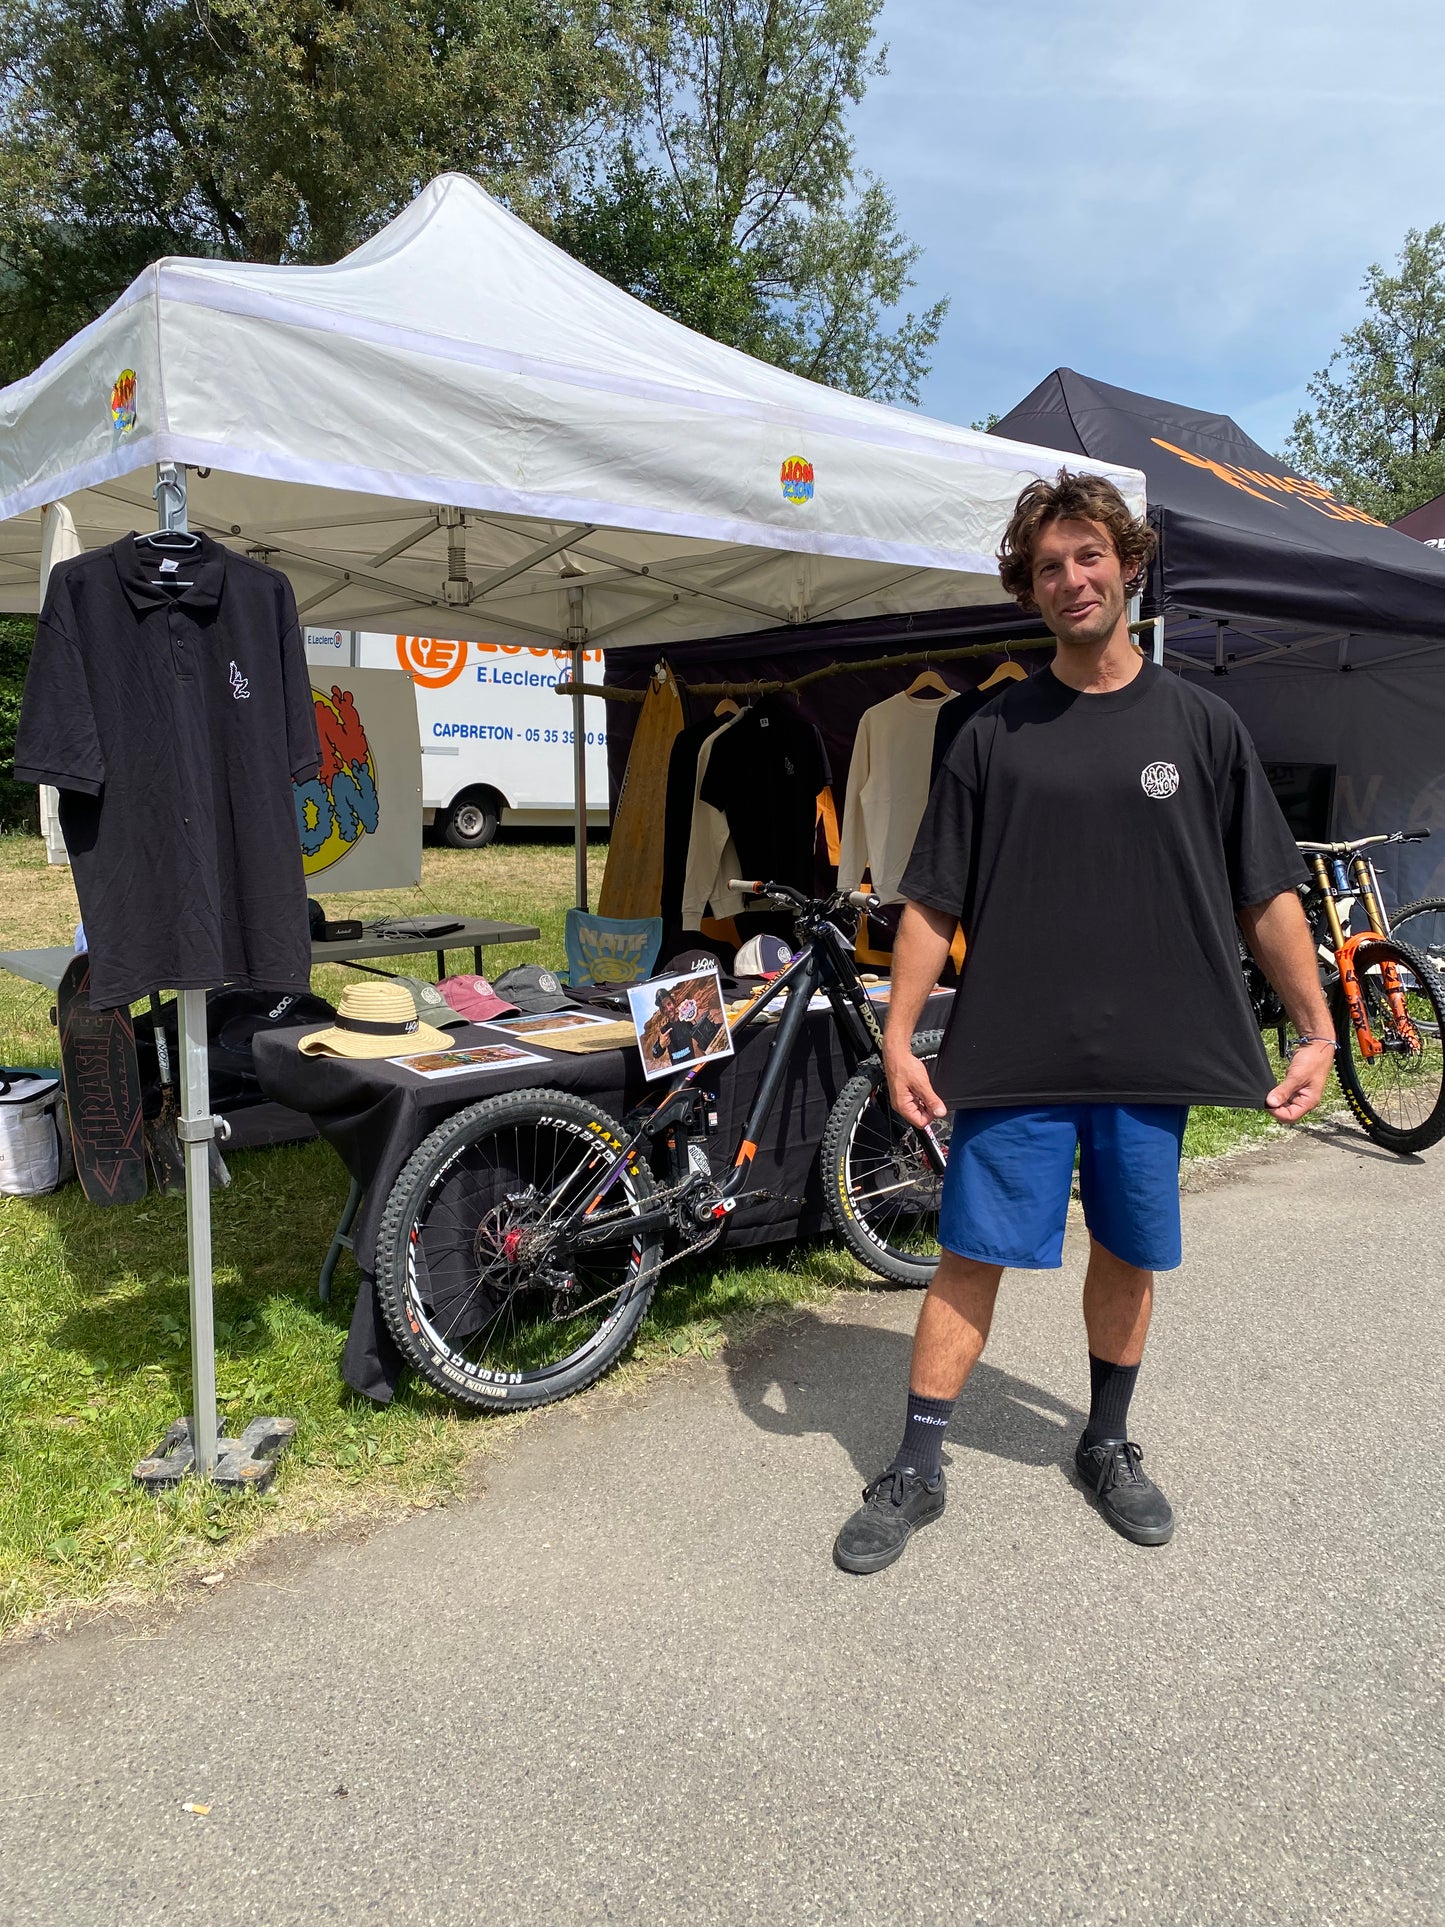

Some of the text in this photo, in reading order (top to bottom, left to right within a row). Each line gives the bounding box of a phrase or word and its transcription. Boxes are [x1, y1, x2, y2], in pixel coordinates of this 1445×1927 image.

[477, 667, 557, 688] E.Leclerc
[432, 722, 513, 741] CAPBRETON
[525, 728, 540, 742] 05
[544, 730, 558, 744] 35
[586, 1121, 640, 1176] MAXS
[429, 1145, 466, 1188] NOVATEC
